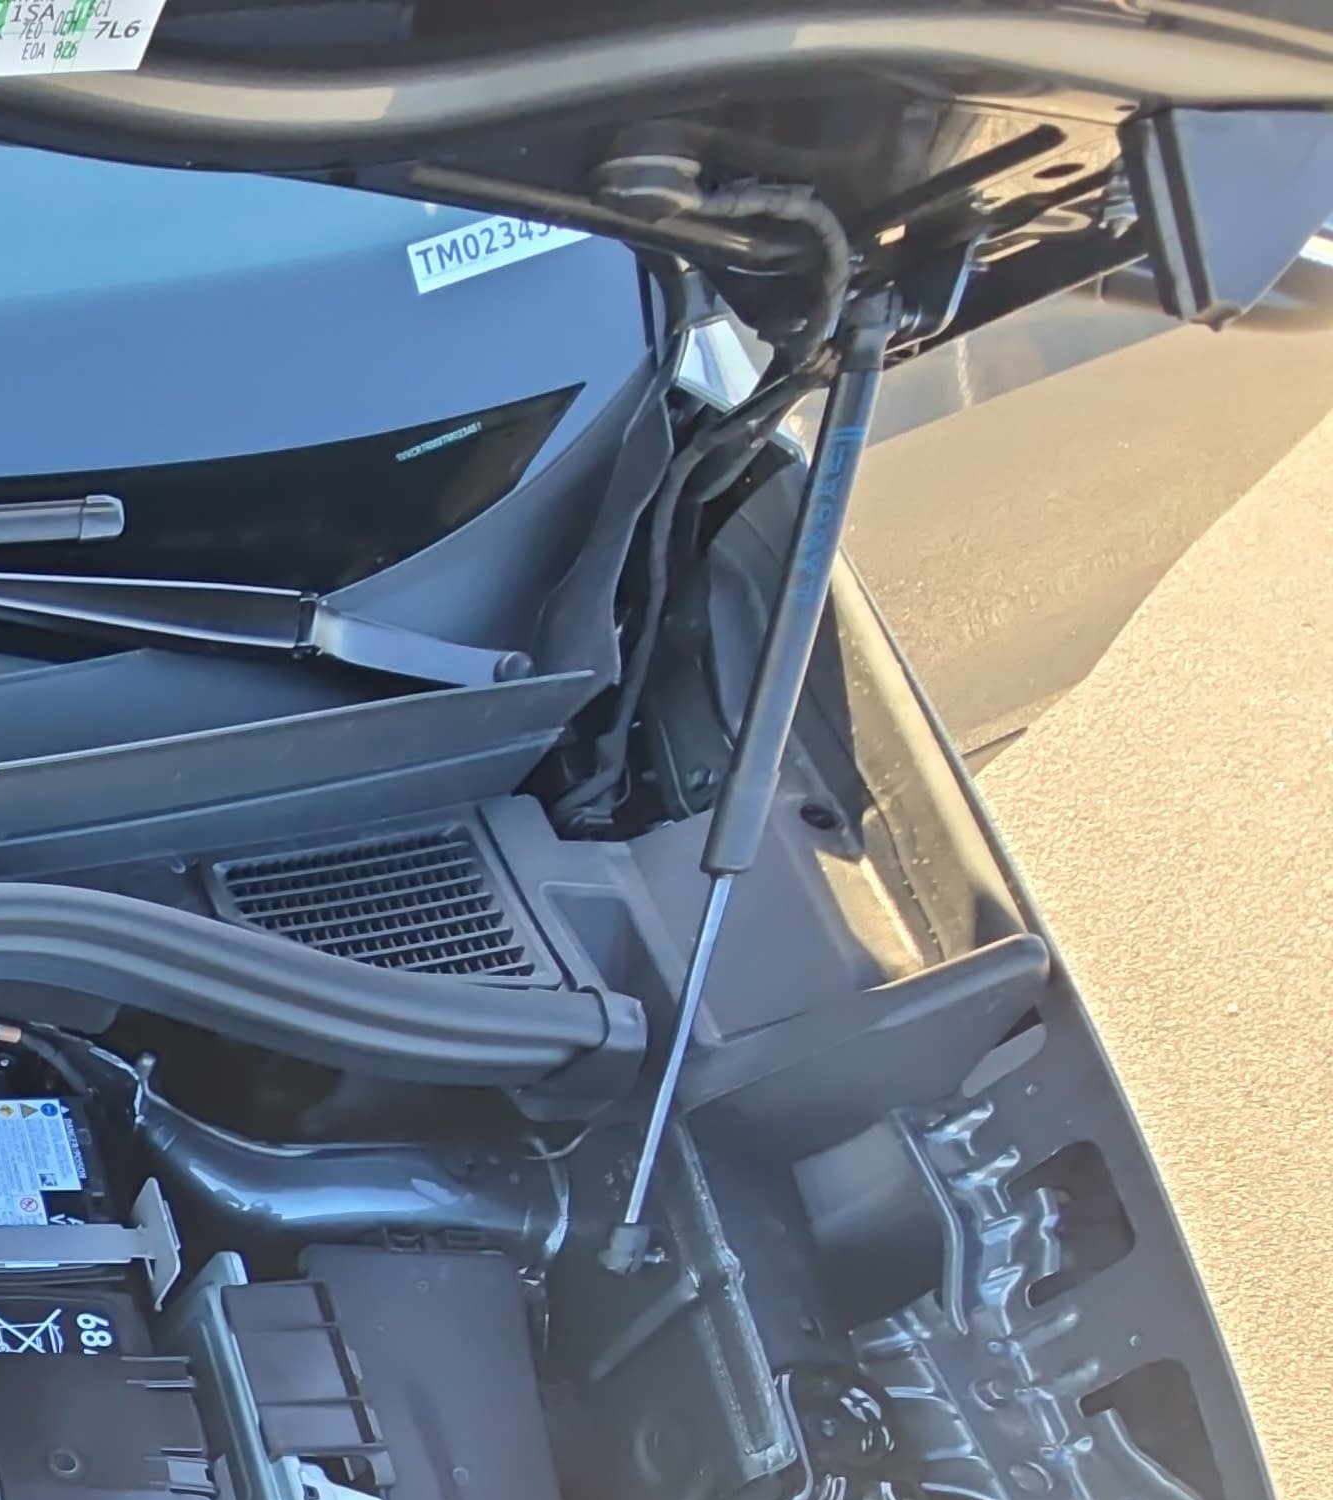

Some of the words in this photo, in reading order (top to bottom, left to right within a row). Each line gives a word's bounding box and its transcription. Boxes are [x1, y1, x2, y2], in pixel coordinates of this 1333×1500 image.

[10, 4, 55, 22] 1SA
[95, 20, 141, 39] 7L6
[76, 1313, 112, 1354] 68
